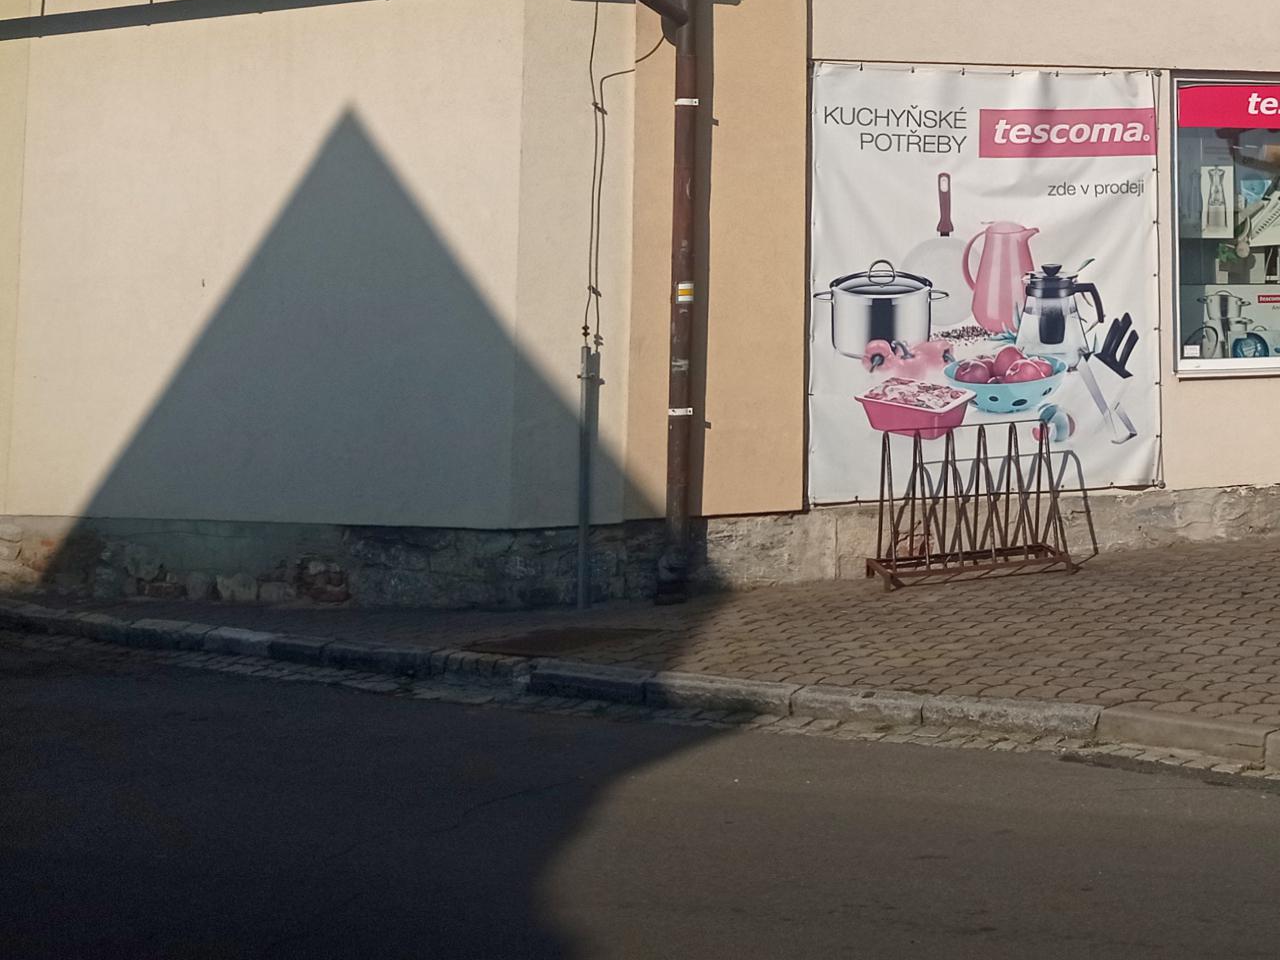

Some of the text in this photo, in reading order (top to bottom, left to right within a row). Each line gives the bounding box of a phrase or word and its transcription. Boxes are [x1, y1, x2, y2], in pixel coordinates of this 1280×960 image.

[824, 105, 967, 130] KUCHYŇSKÉ
[860, 130, 967, 154] POTŘEBY
[1048, 180, 1145, 198] zde v prodeji
